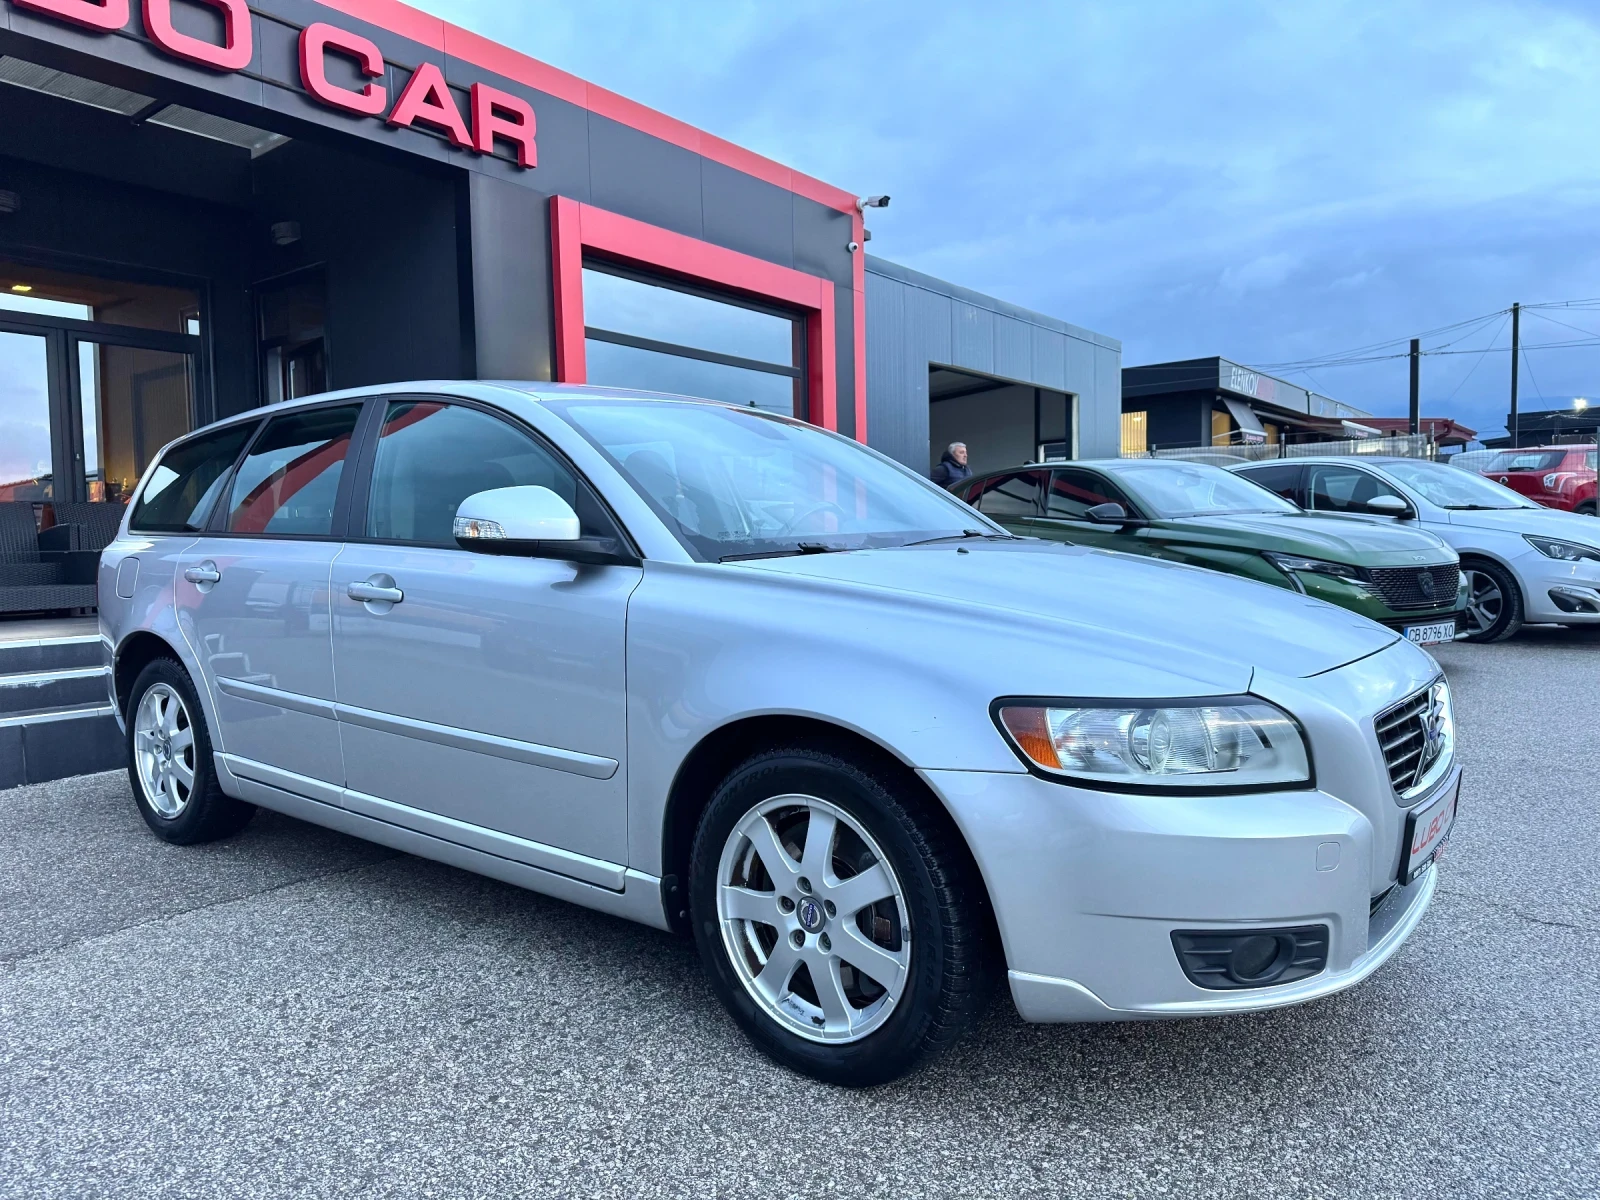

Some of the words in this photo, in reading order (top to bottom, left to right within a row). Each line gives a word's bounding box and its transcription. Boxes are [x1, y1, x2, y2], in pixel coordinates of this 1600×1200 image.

[299, 22, 537, 169] CAR
[1230, 366, 1260, 396] ELENKOV
[1409, 628, 1421, 642] CB
[1422, 626, 1442, 641] 8796
[1443, 624, 1454, 638] XO
[1411, 809, 1445, 855] LUBO
